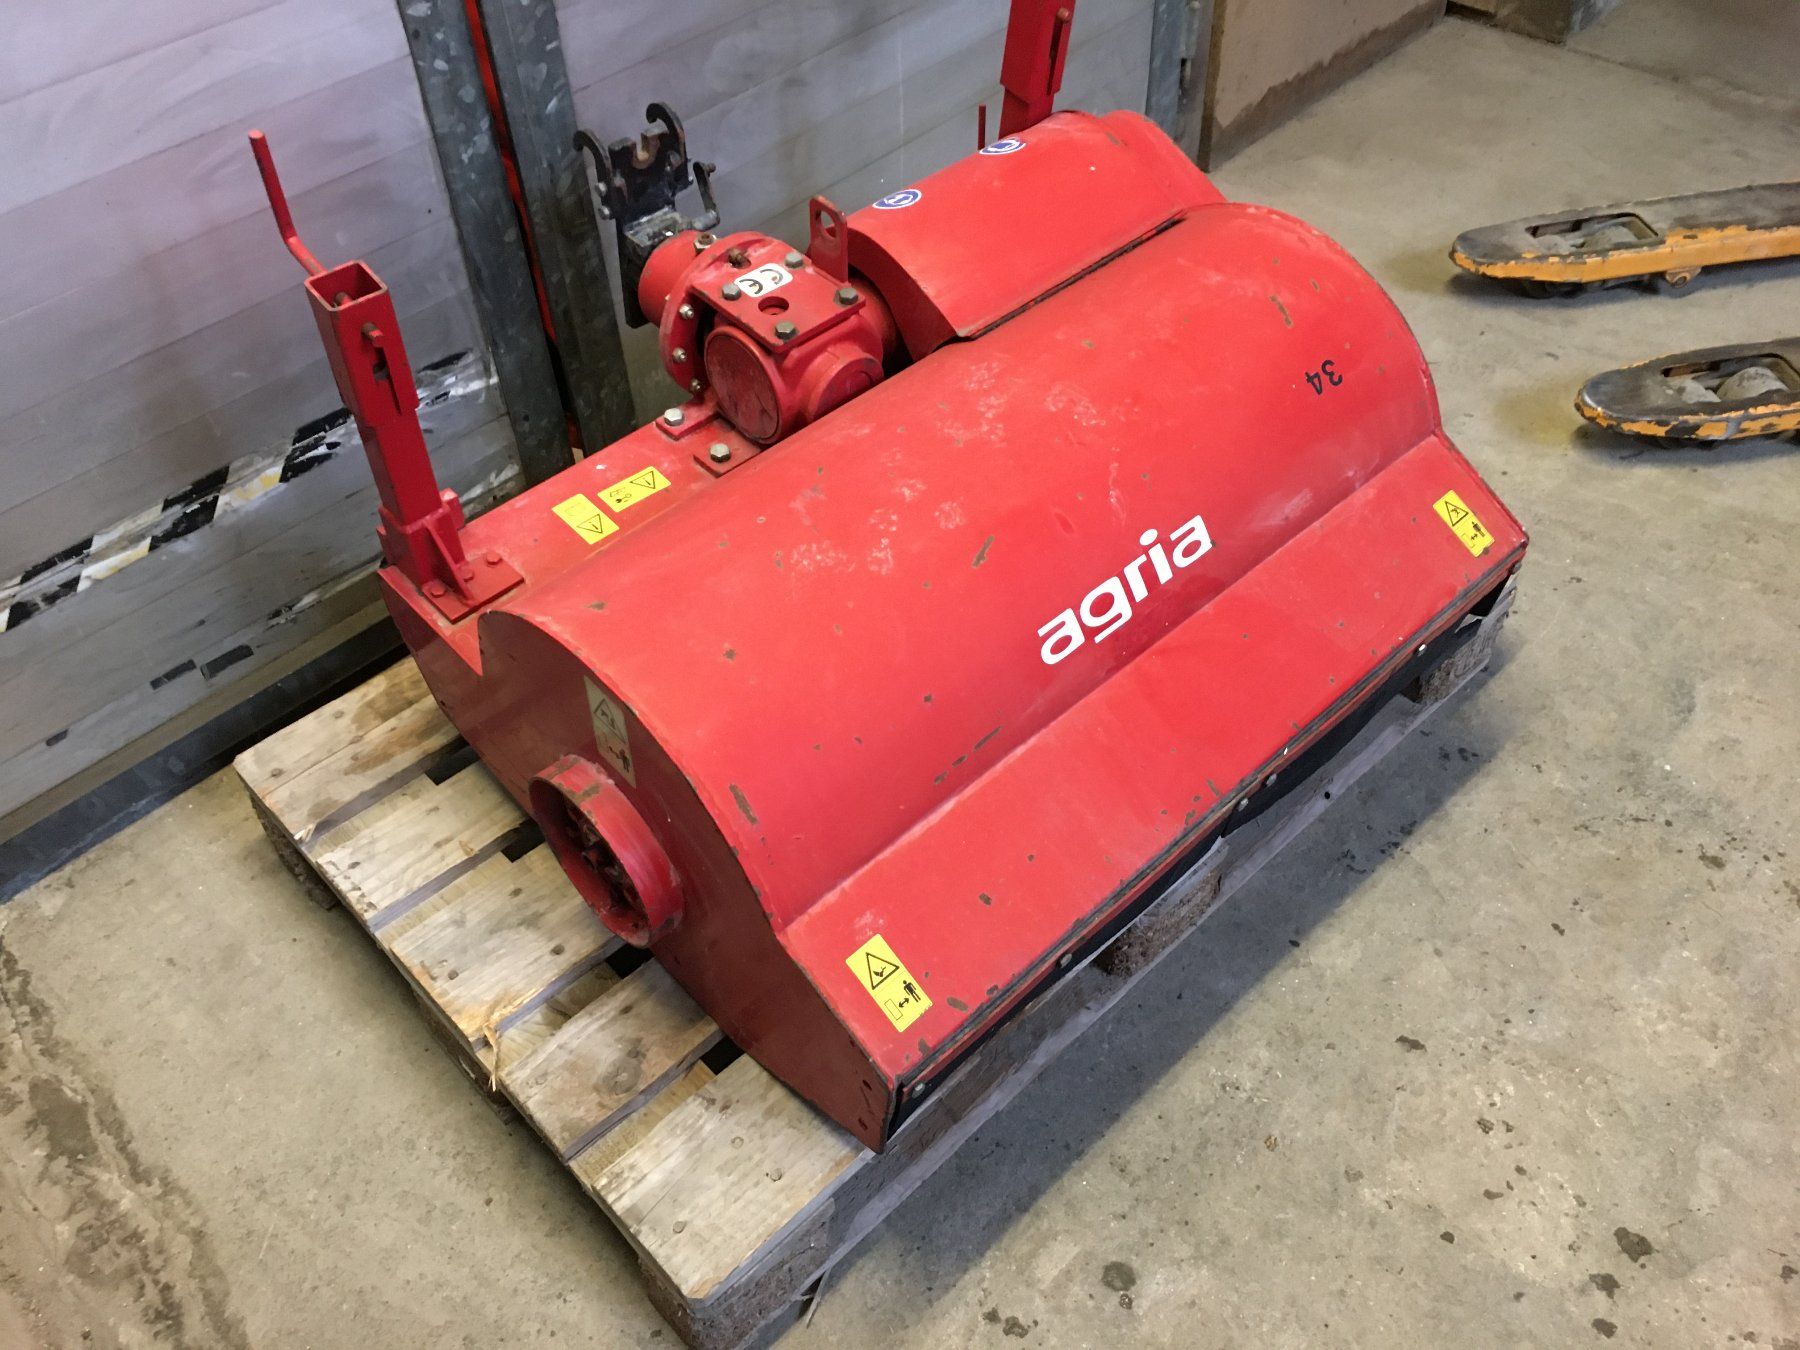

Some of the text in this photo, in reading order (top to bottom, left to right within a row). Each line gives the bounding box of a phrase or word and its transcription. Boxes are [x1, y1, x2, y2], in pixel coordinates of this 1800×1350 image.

[739, 268, 784, 295] CE
[1304, 359, 1343, 395] 34
[1037, 514, 1213, 665] agria
